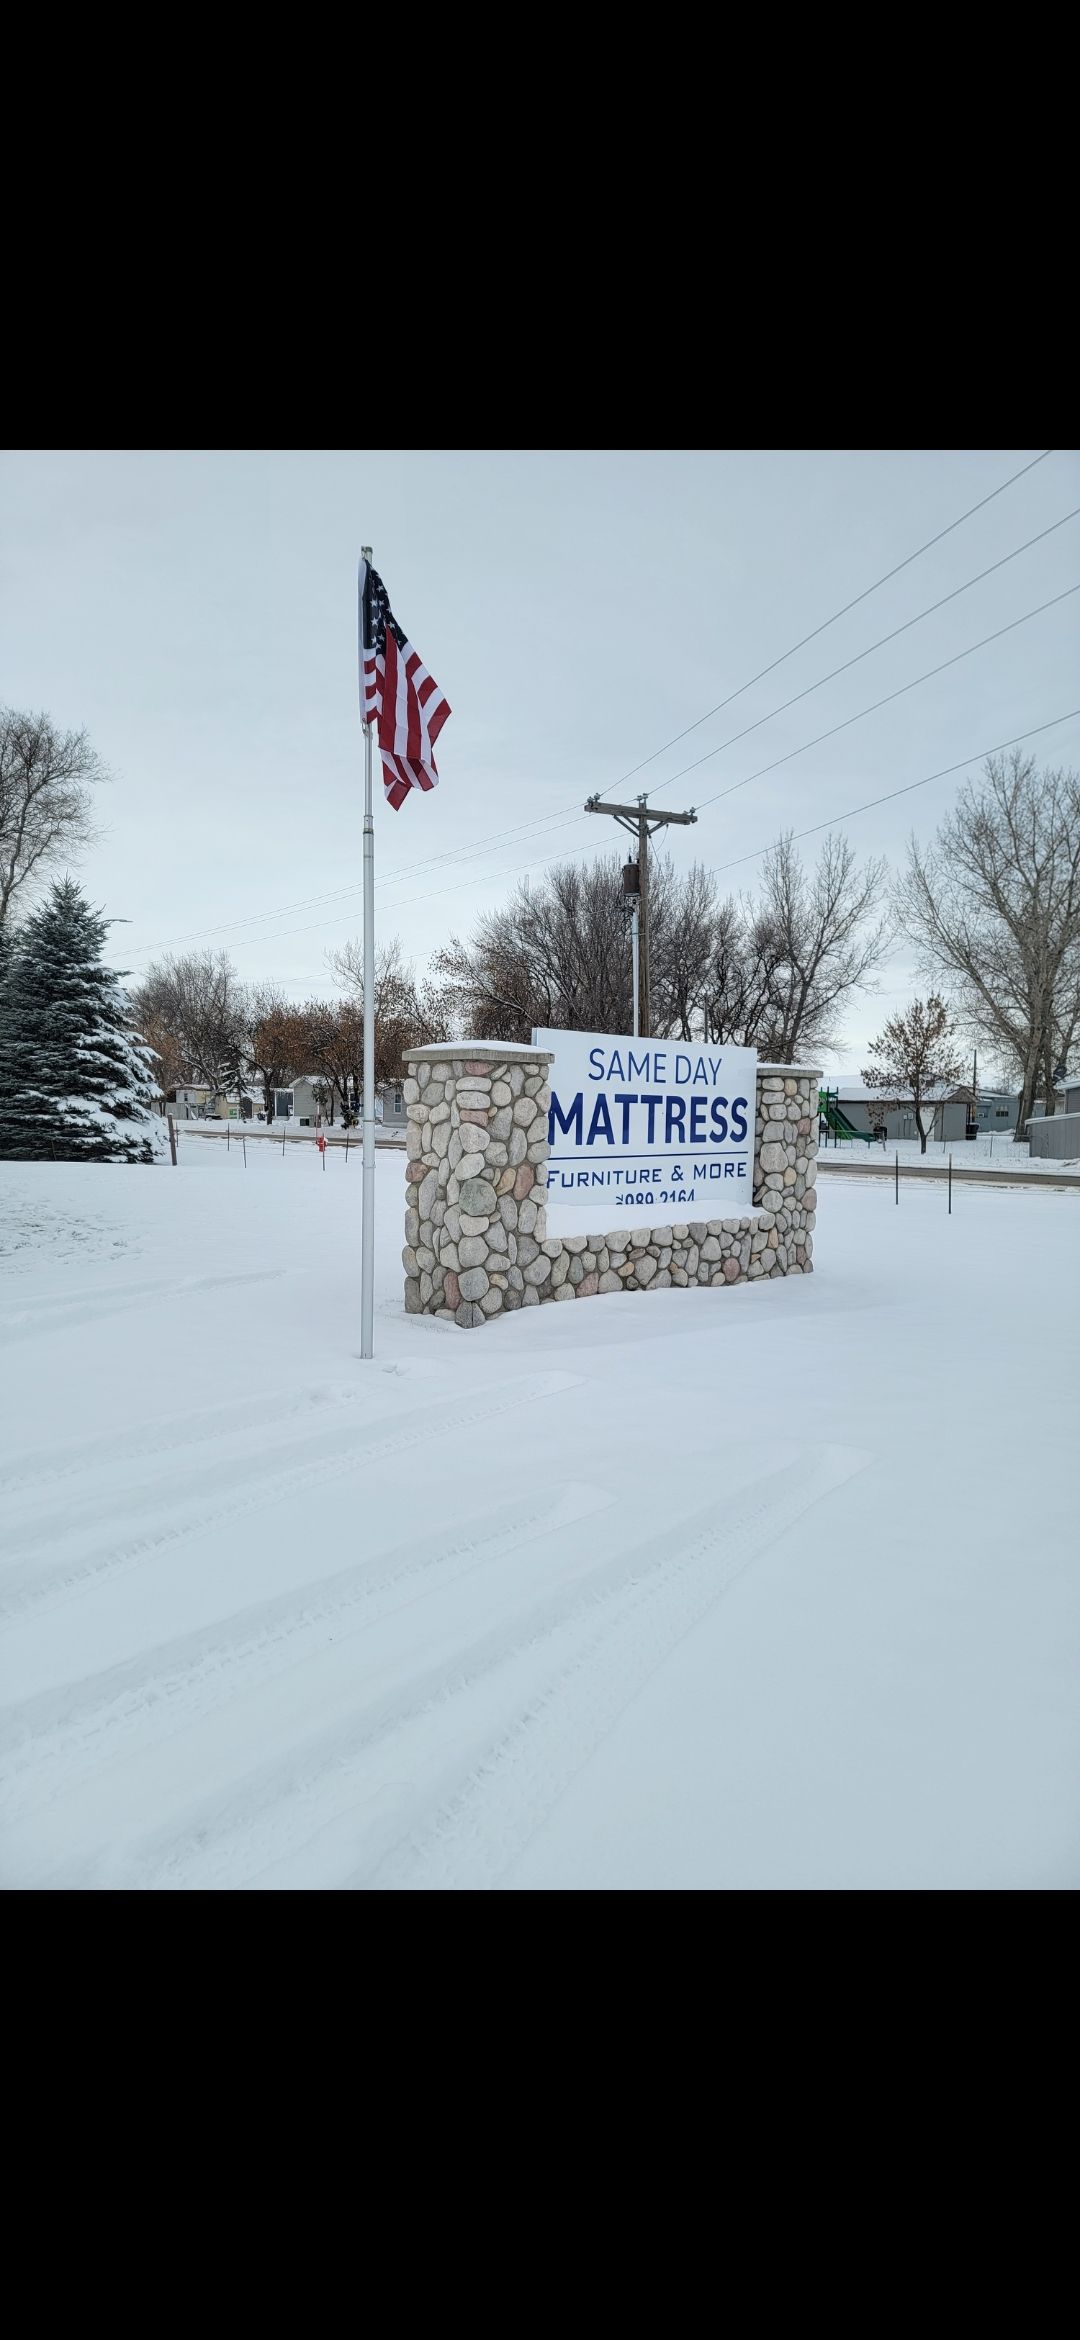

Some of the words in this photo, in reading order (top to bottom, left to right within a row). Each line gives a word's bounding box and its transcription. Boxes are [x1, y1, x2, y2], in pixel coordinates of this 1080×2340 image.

[588, 1048, 667, 1084] SAME
[675, 1054, 723, 1086] DAY
[547, 1091, 749, 1146] MATTRESS
[670, 1164, 684, 1182] &
[693, 1161, 747, 1181] MORE
